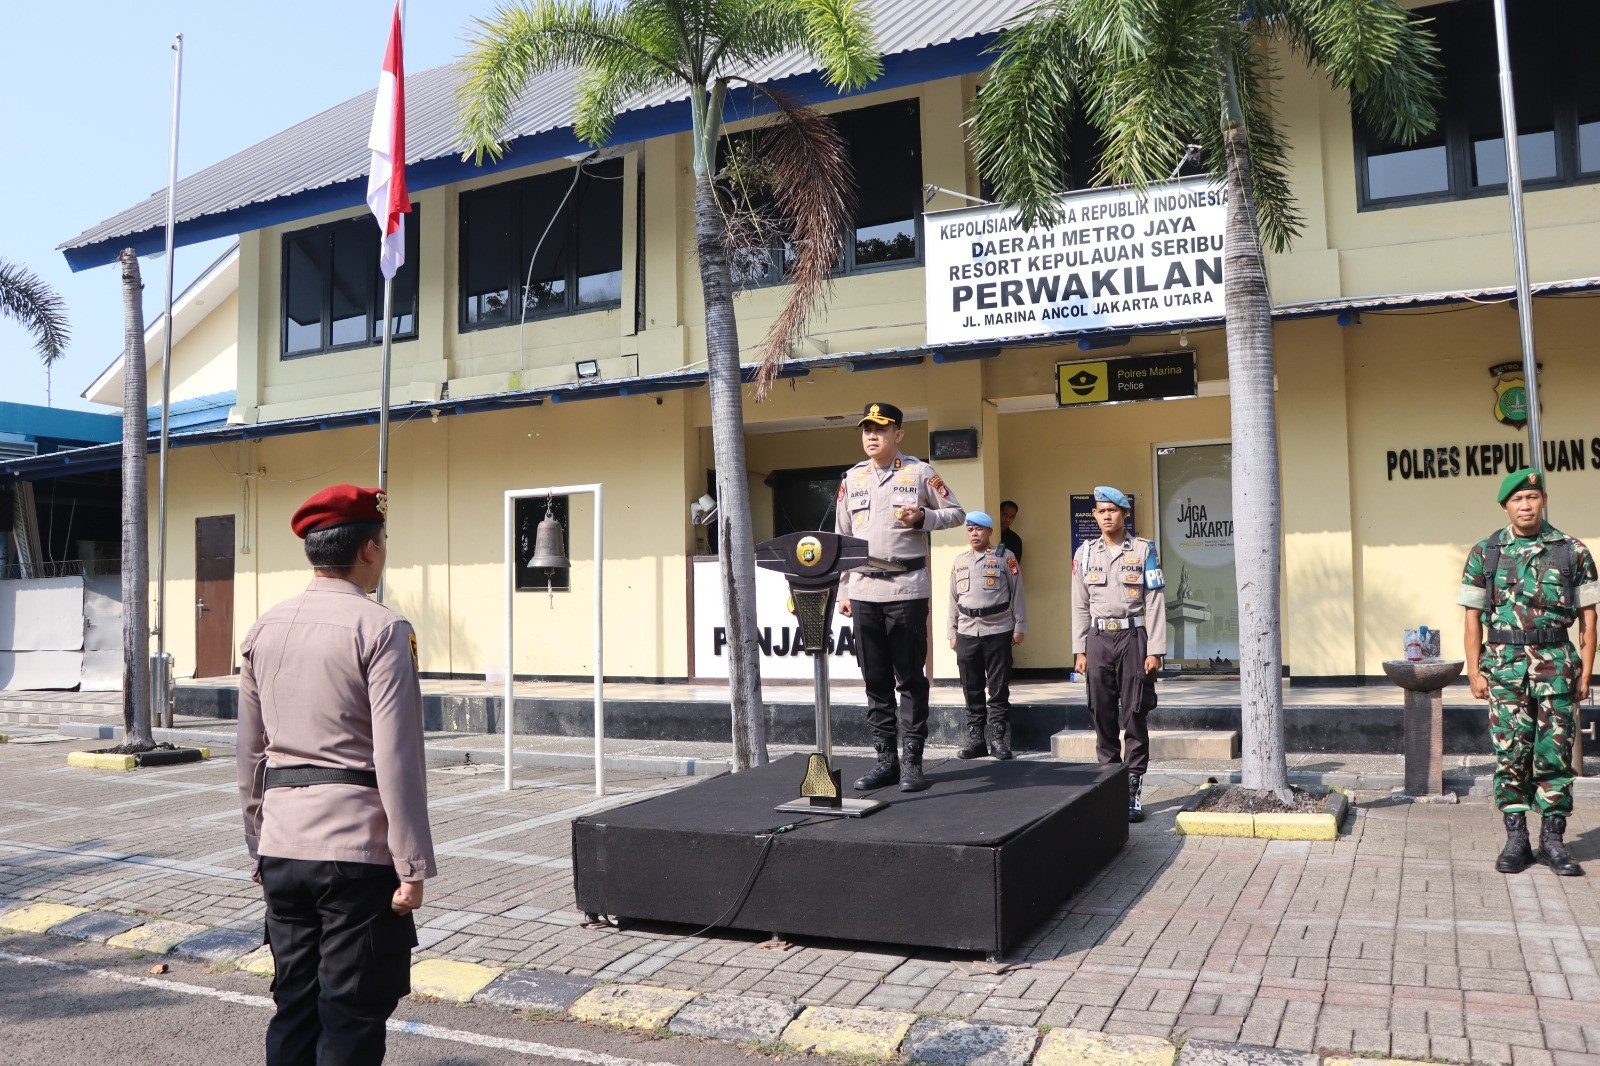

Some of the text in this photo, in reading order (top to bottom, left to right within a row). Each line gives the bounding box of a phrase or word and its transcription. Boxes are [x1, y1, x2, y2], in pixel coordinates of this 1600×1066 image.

[1082, 199, 1149, 222] REPUBLIK
[971, 216, 1196, 258] DAERAH METRO JAYA
[949, 234, 1223, 281] RESORT KEPULAUAN SERIBU
[953, 256, 1223, 312] PERWAKILAN
[962, 291, 1213, 328] JL. MARINA ANCOL JAKARTA UTARA
[1117, 366, 1182, 379] Polres Marina
[1493, 363, 1519, 373] METRO
[1117, 382, 1144, 391] Police
[1386, 446, 1461, 481] POLRES
[1465, 438, 1585, 477] KEPULUAN
[850, 489, 869, 498] ARGA
[893, 486, 917, 494] POLRI
[1177, 503, 1207, 522] JAGA
